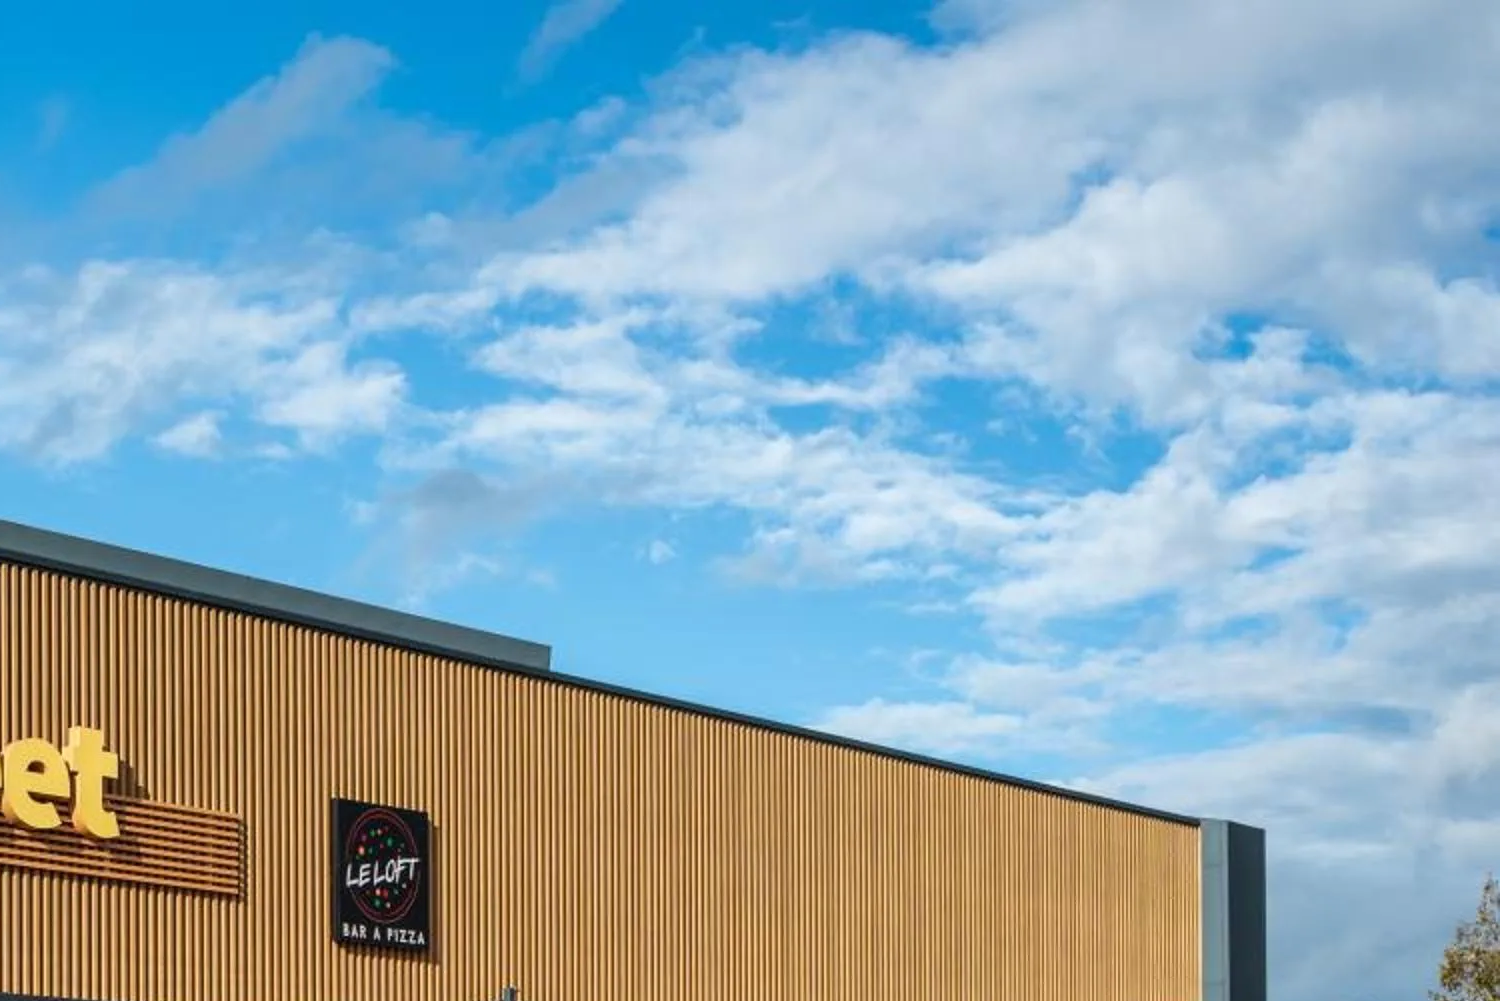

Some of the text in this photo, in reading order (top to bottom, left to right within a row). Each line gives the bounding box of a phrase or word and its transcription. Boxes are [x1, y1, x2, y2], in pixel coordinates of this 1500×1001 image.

[346, 856, 420, 887] LE LOFT
[342, 922, 367, 939] BAR
[387, 928, 425, 945] PIZZA
